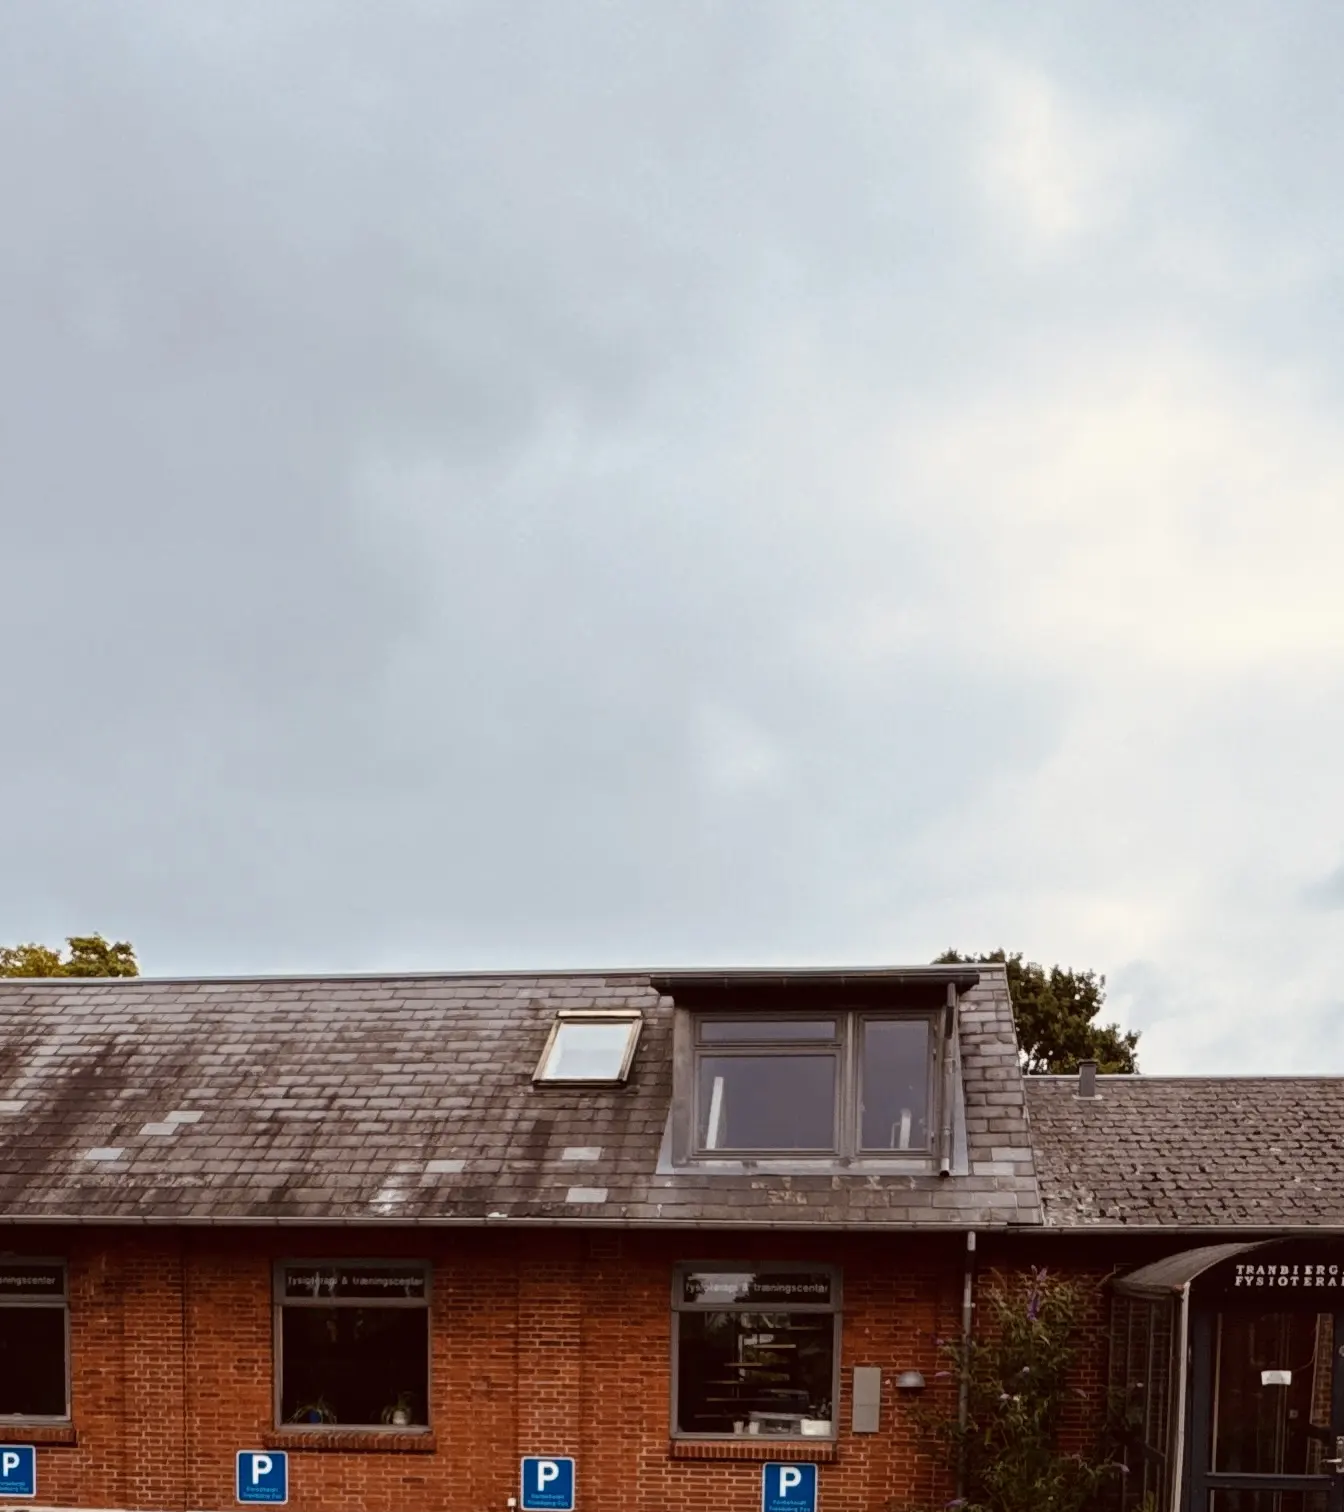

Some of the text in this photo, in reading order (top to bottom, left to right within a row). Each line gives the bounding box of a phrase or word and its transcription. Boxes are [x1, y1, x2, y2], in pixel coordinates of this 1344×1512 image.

[754, 1283, 829, 1294] træningscenter
[2, 1451, 21, 1477] P
[252, 1454, 273, 1485] P
[537, 1460, 560, 1492] P
[779, 1466, 802, 1497] P
